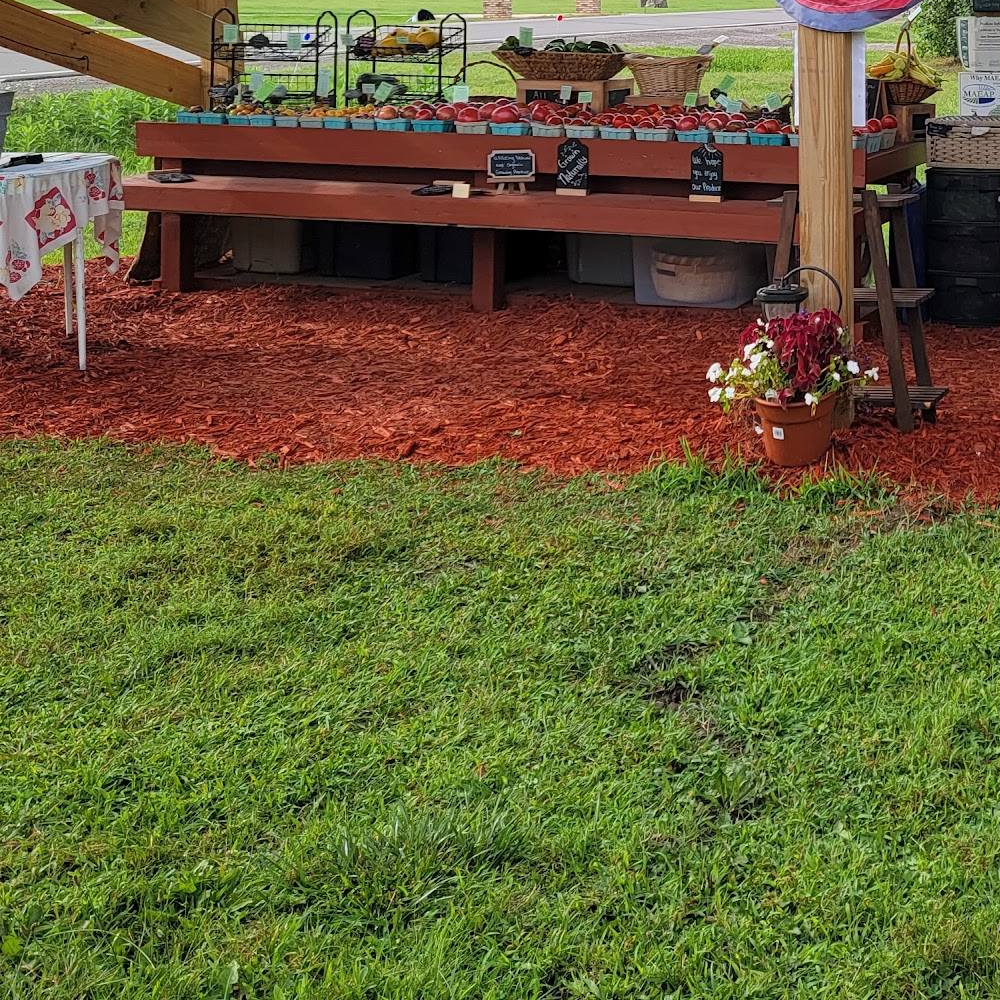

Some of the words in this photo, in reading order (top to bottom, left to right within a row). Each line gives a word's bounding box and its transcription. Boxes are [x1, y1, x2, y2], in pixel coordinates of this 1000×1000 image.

[963, 90, 995, 98] MAEAP
[557, 149, 581, 169] Grown
[692, 155, 703, 165] We
[704, 156, 722, 167] hope
[556, 155, 588, 186] Naturally
